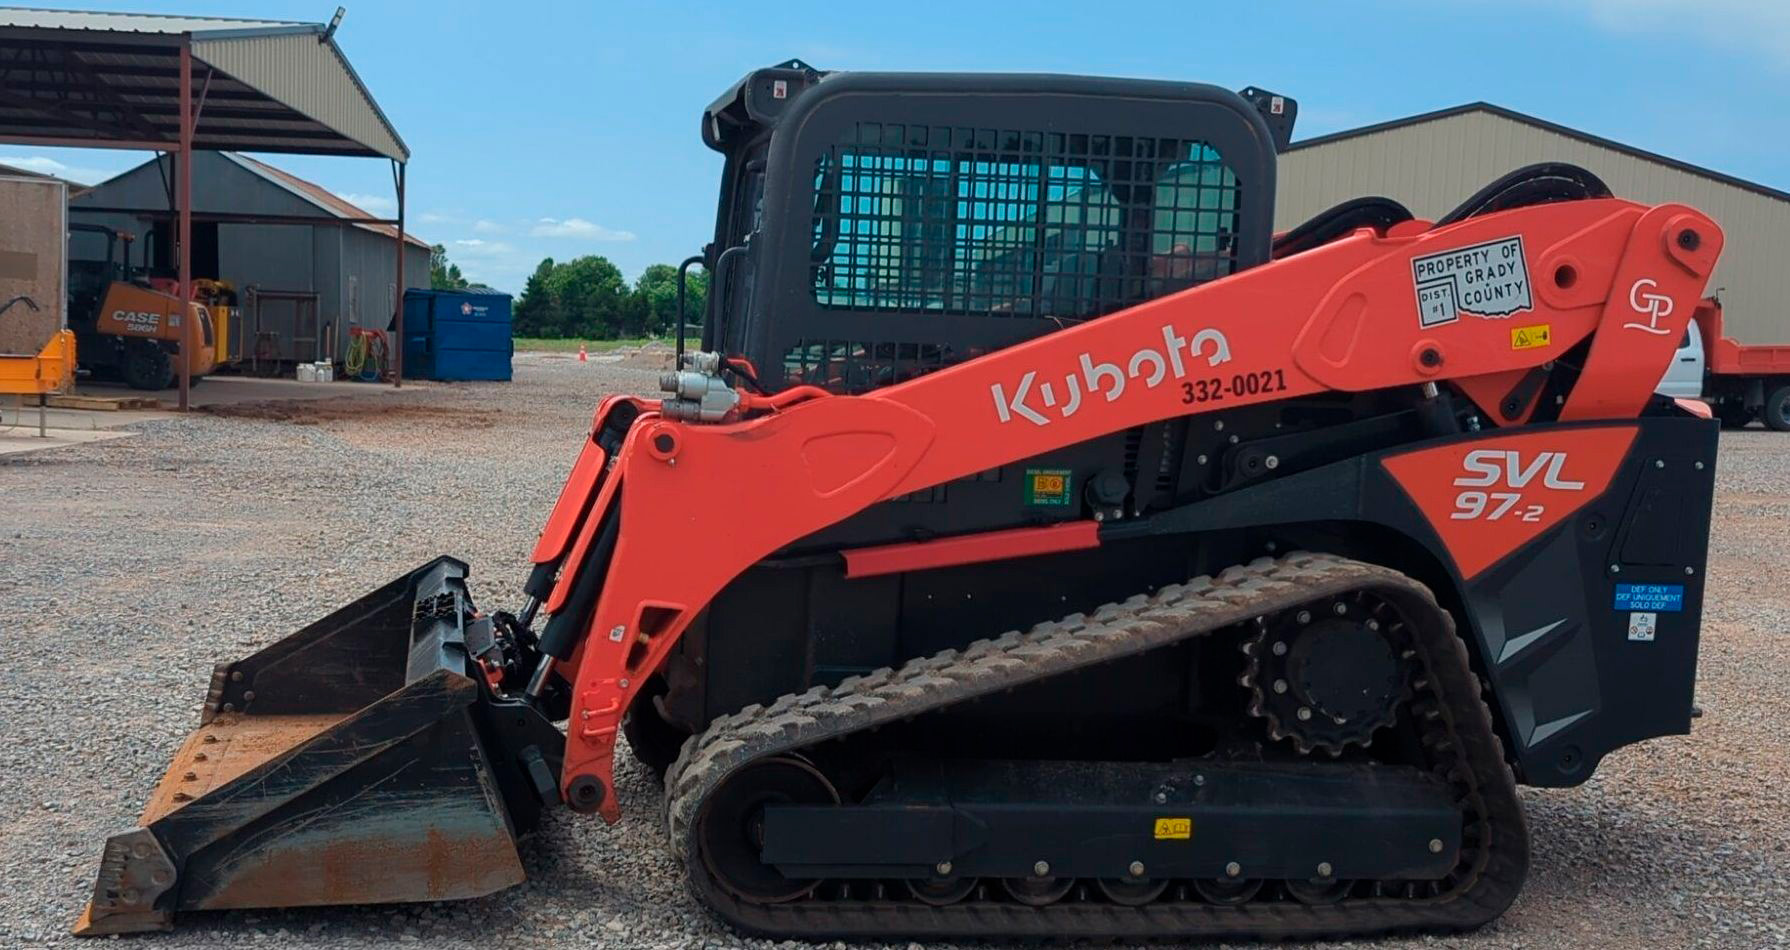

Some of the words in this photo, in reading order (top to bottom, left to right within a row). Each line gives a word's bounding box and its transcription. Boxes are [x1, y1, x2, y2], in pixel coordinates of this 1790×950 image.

[1418, 249, 1489, 278] PROPERTY
[1501, 242, 1518, 259] OF
[1465, 261, 1516, 284] GRADY
[1464, 280, 1524, 305] COUNTY
[112, 310, 160, 324] CASE
[1432, 301, 1446, 317] #1
[991, 325, 1232, 426] Kubota
[1181, 369, 1287, 404] 332-0021
[1453, 449, 1585, 490] SVL
[1450, 491, 1544, 522] 97-2
[1616, 593, 1630, 601] DEF
[1632, 593, 1680, 602] UNIQUEMENT
[1631, 585, 1646, 593] DEF
[1648, 586, 1668, 594] ONLY
[1651, 601, 1666, 609] DEF
